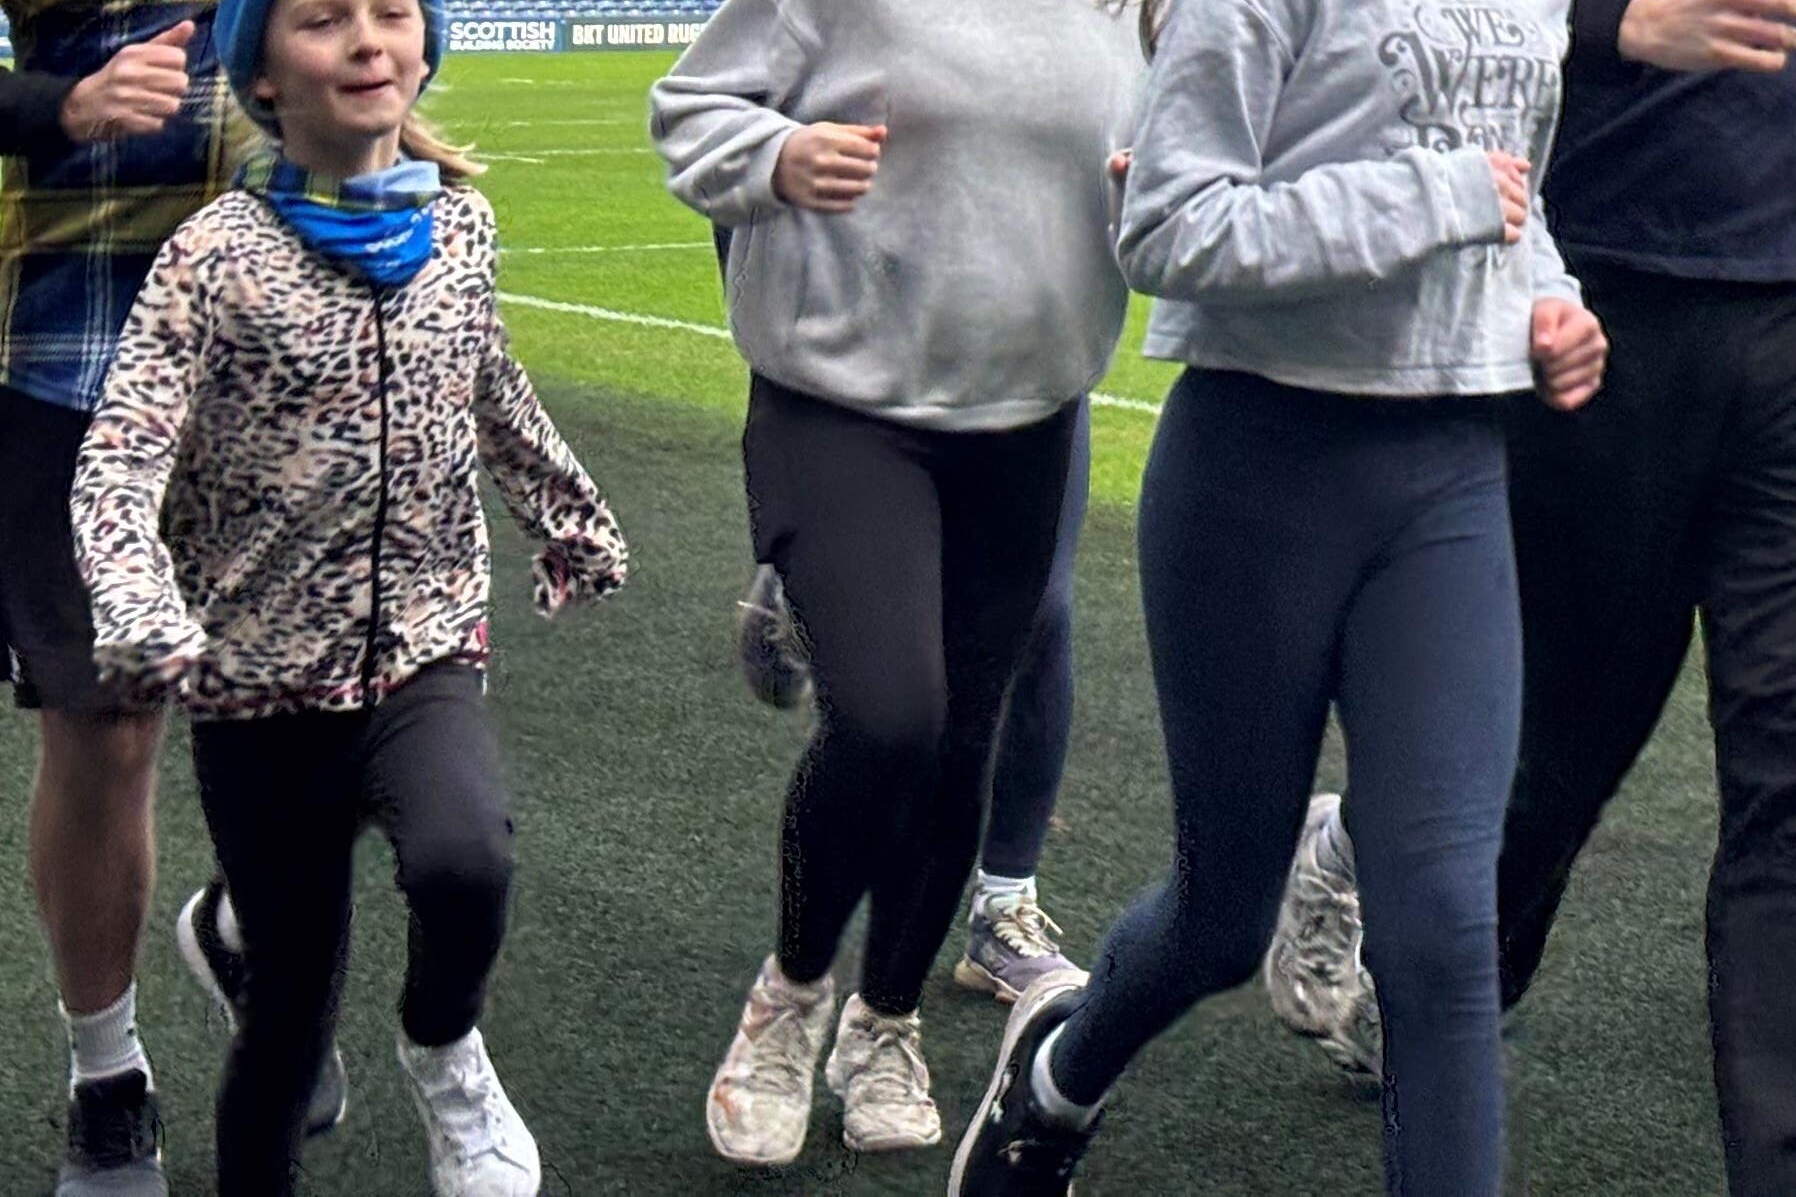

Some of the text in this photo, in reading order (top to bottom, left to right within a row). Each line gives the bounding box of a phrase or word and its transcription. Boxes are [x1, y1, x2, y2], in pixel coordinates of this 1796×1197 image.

[450, 21, 556, 40] SCOTTISH
[573, 24, 604, 45] BKT
[607, 24, 665, 44] UNITED
